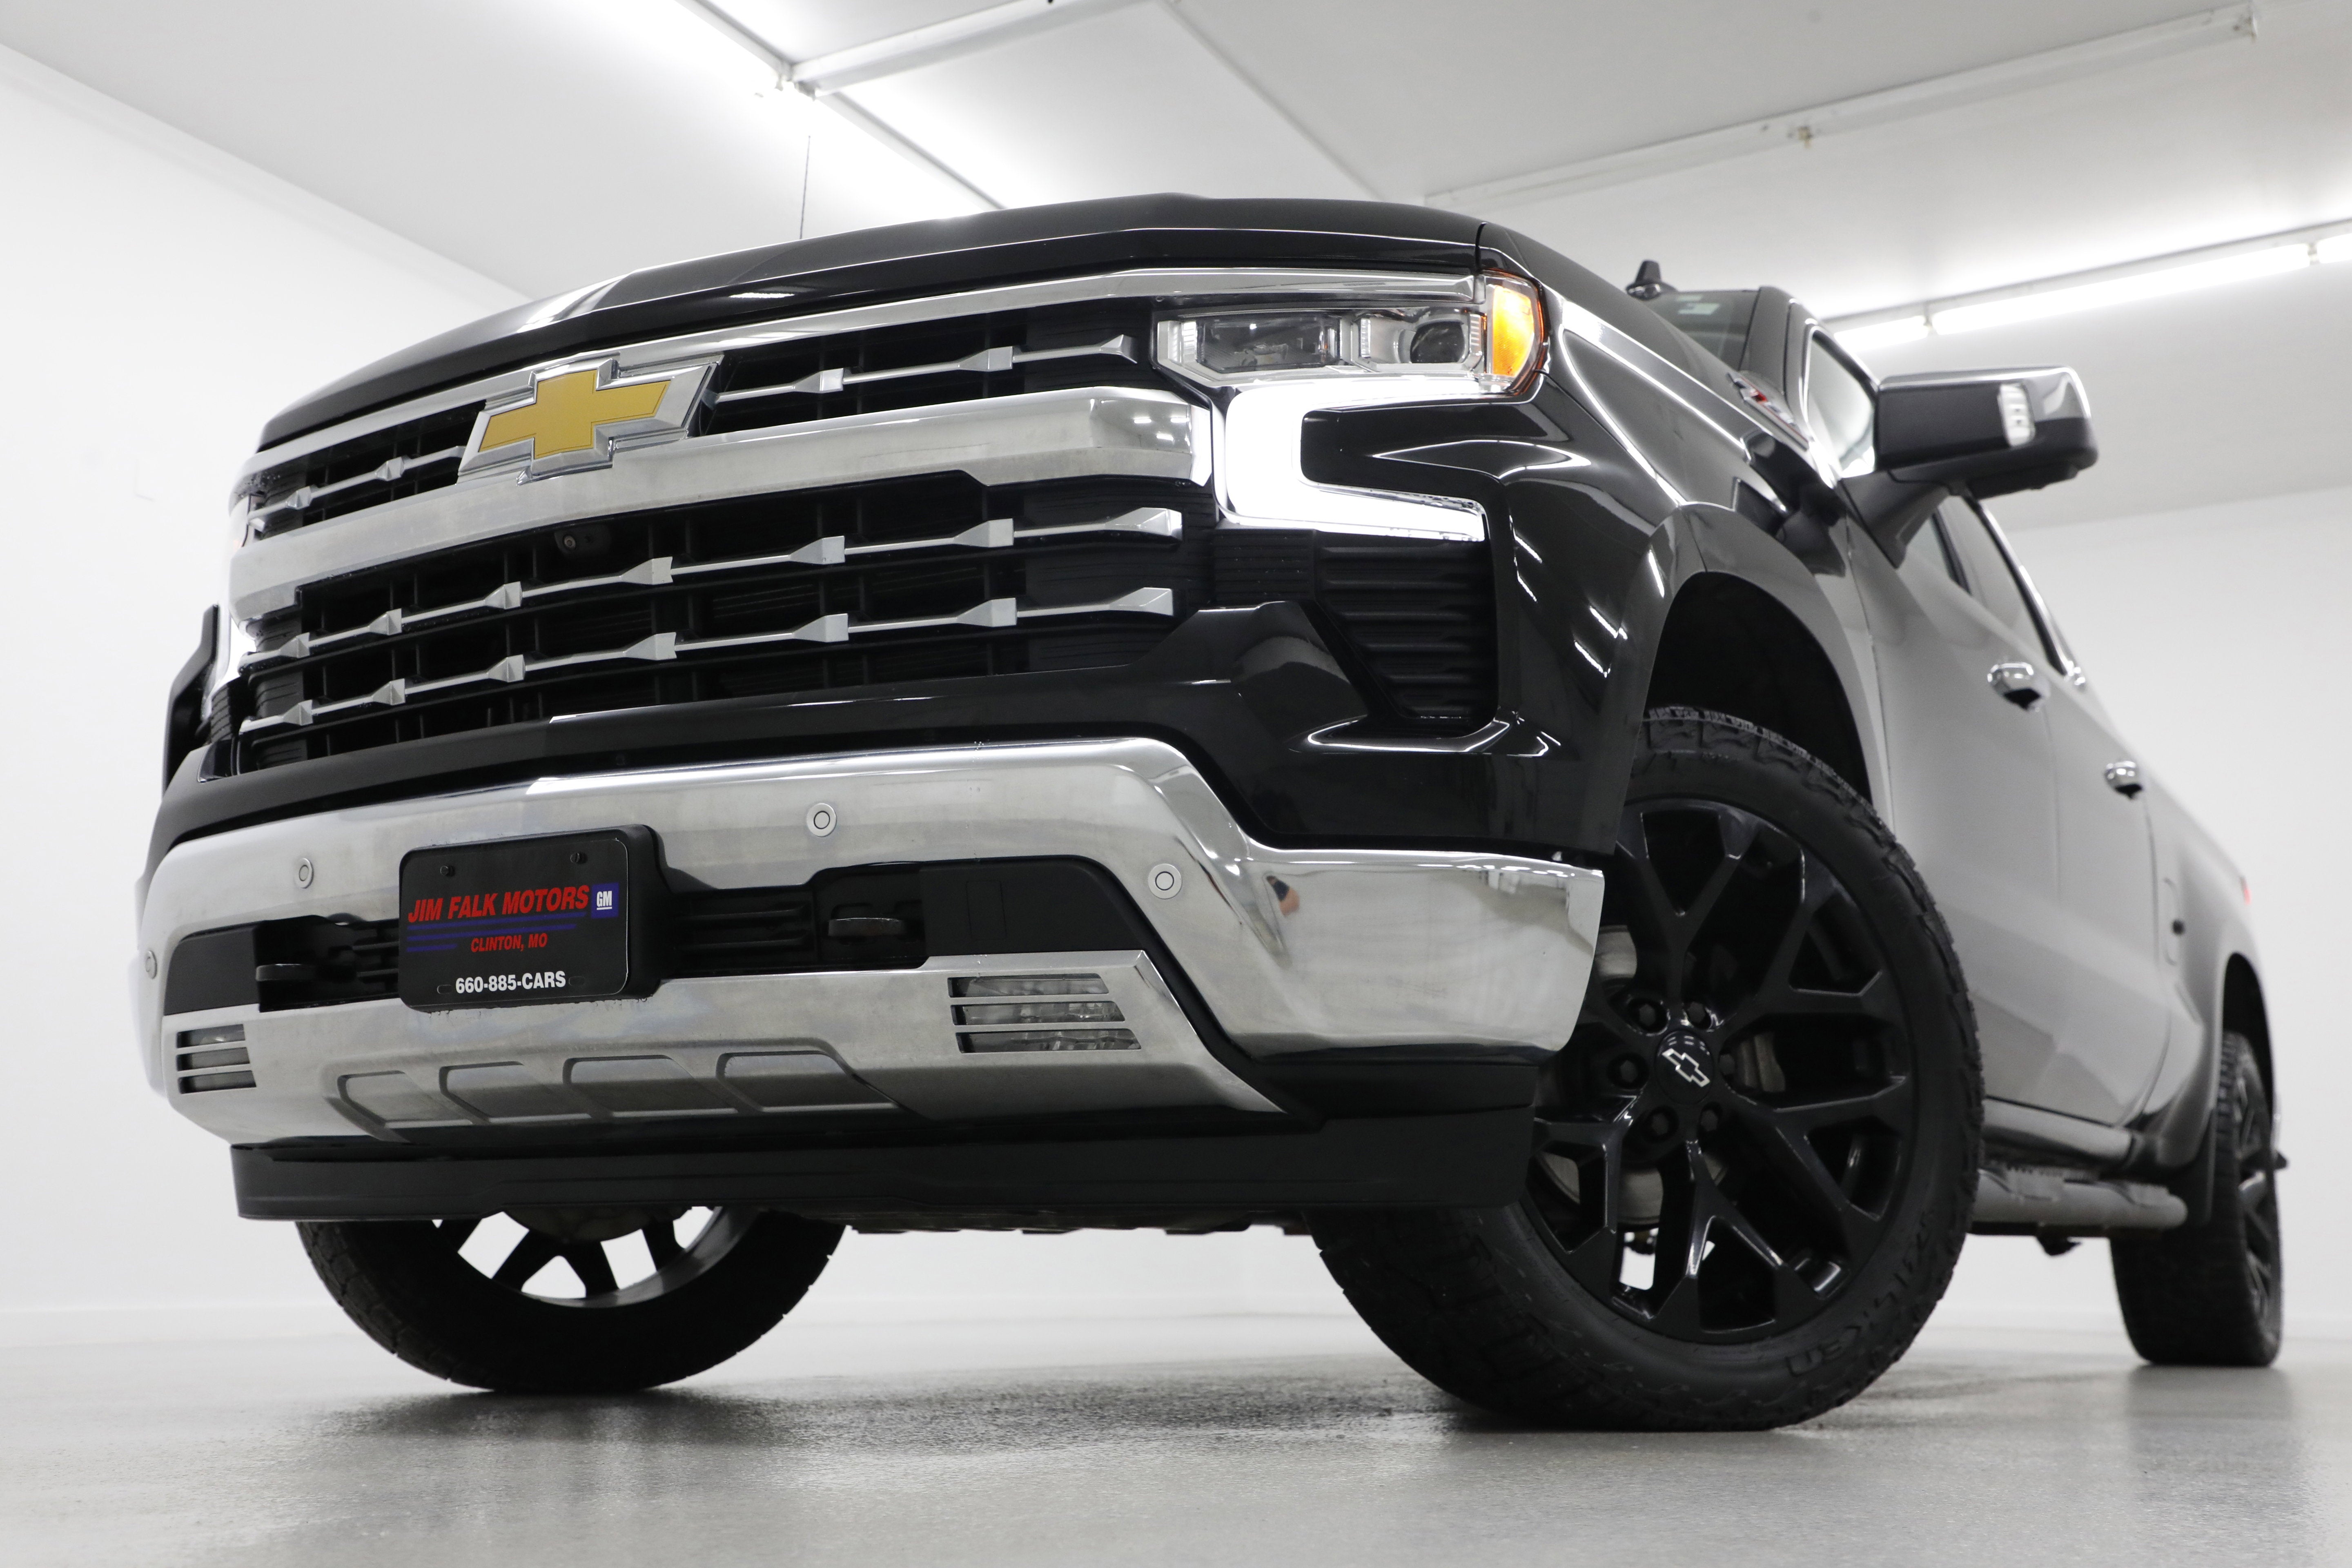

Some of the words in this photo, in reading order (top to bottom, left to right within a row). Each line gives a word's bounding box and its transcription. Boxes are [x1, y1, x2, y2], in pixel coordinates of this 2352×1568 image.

[408, 898, 443, 923] JIM
[448, 893, 498, 919] FALK
[502, 885, 590, 915] MOTORS
[596, 891, 612, 907] GM
[471, 935, 524, 952] CLINTON,
[528, 933, 548, 948] MO
[456, 971, 566, 993] 660-885-CARS
